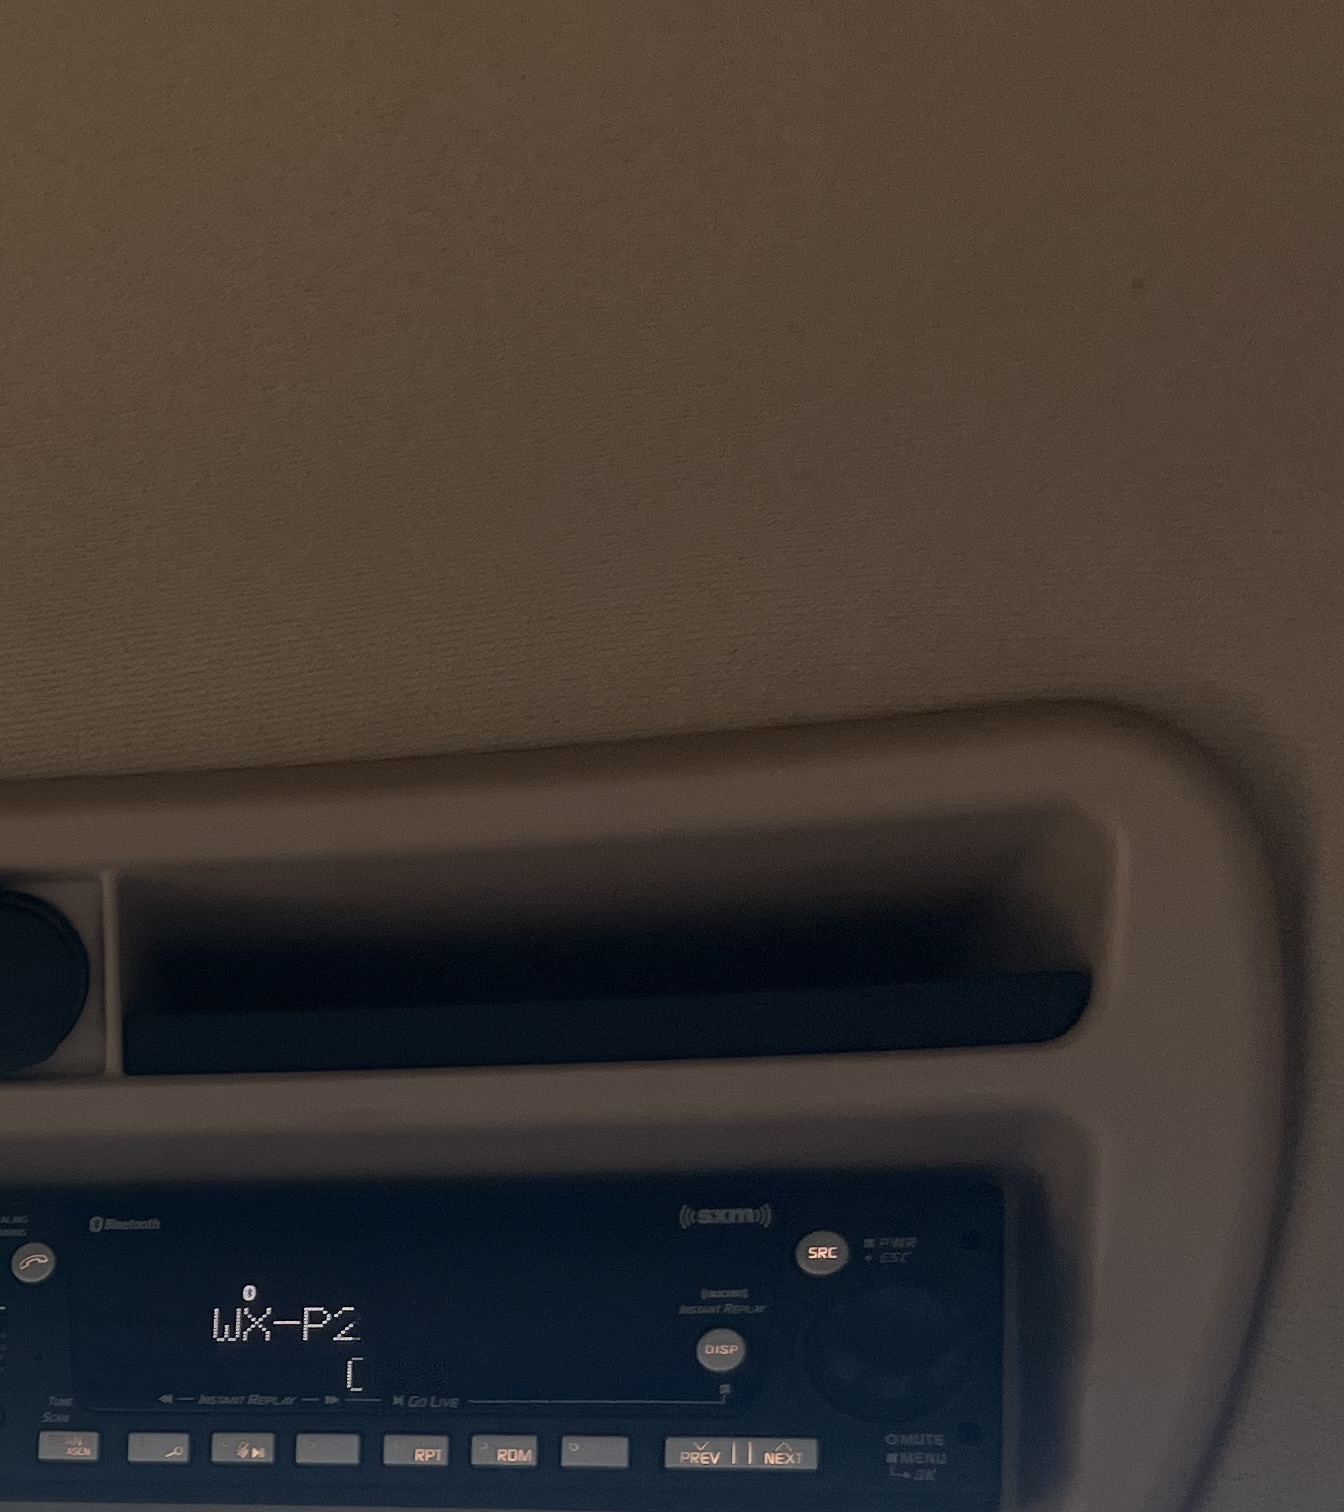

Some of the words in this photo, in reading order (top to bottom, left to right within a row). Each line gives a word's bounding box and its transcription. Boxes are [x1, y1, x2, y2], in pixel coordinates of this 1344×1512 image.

[807, 1246, 838, 1259] SRC
[212, 1306, 362, 1342] WX-P2
[704, 1344, 740, 1356] DISP
[899, 1433, 945, 1447] MUTE
[414, 1448, 442, 1462] RPT
[496, 1448, 533, 1462] RDM
[679, 1451, 723, 1465] PREV
[763, 1451, 803, 1465] NEXT
[900, 1452, 947, 1465] MENU
